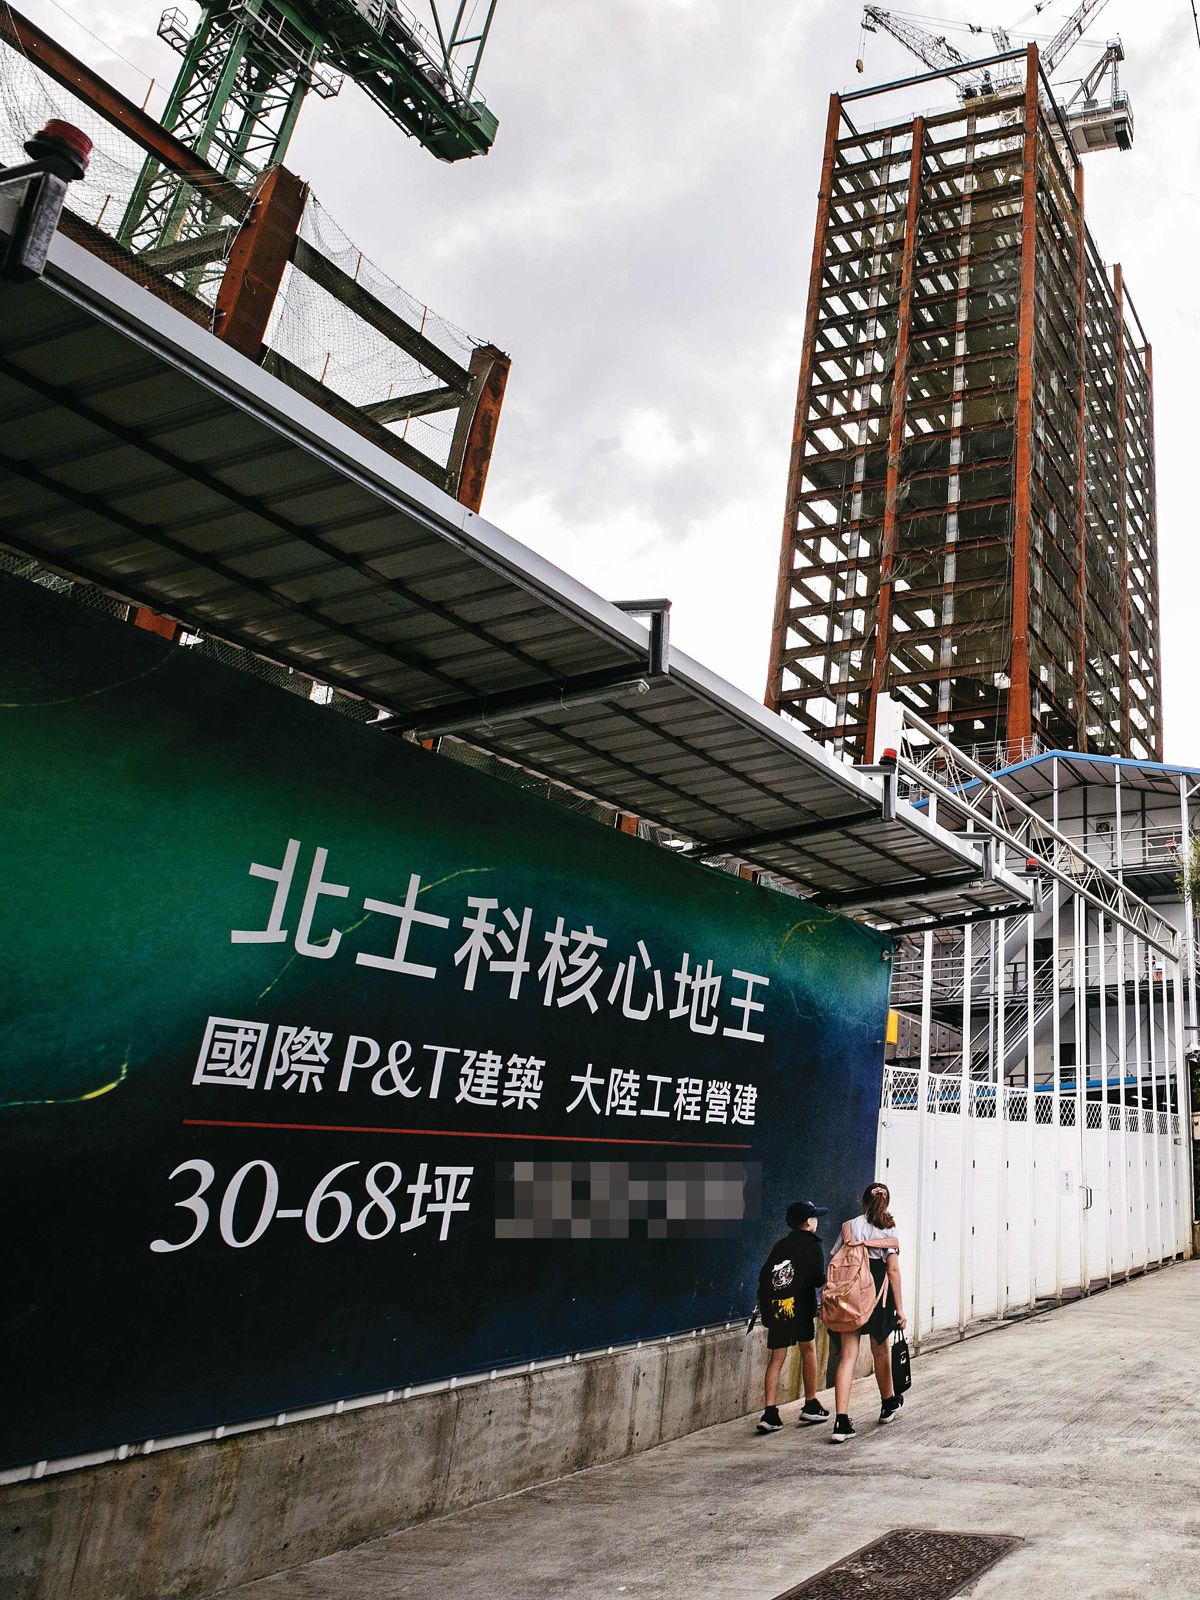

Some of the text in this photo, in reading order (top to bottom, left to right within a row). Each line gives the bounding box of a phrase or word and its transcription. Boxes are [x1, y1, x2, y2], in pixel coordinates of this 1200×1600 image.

[232, 839, 769, 1042] 北士科核心地王
[566, 1064, 757, 1125] 大陸工程營建
[150, 1160, 473, 1252] 30-68坪
